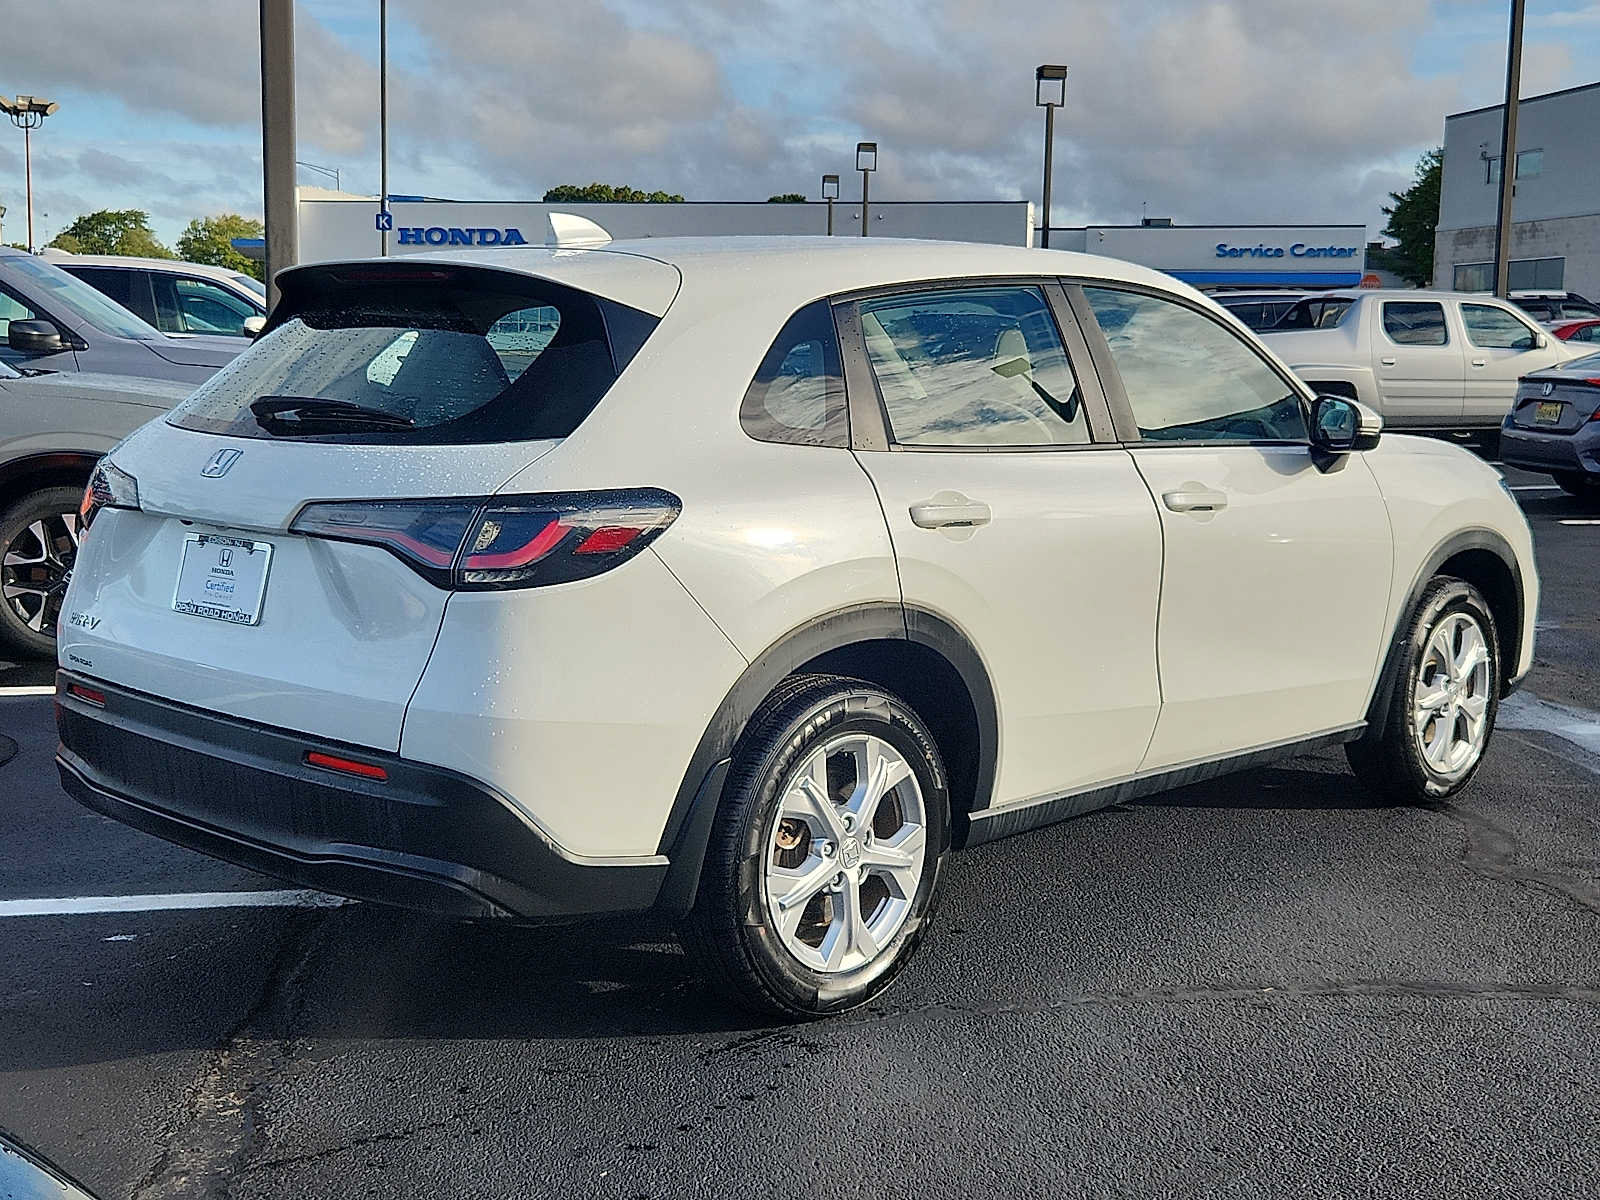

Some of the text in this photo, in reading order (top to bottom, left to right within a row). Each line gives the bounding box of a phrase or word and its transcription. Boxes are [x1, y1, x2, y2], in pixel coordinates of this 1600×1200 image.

[379, 215, 390, 229] K
[397, 227, 528, 245] HONDA
[1216, 243, 1357, 258] Service Center
[211, 567, 234, 576] HONDA
[206, 579, 235, 593] Certified
[175, 602, 197, 614] OPEN
[198, 606, 220, 617] ROAD
[221, 611, 251, 623] HONDA
